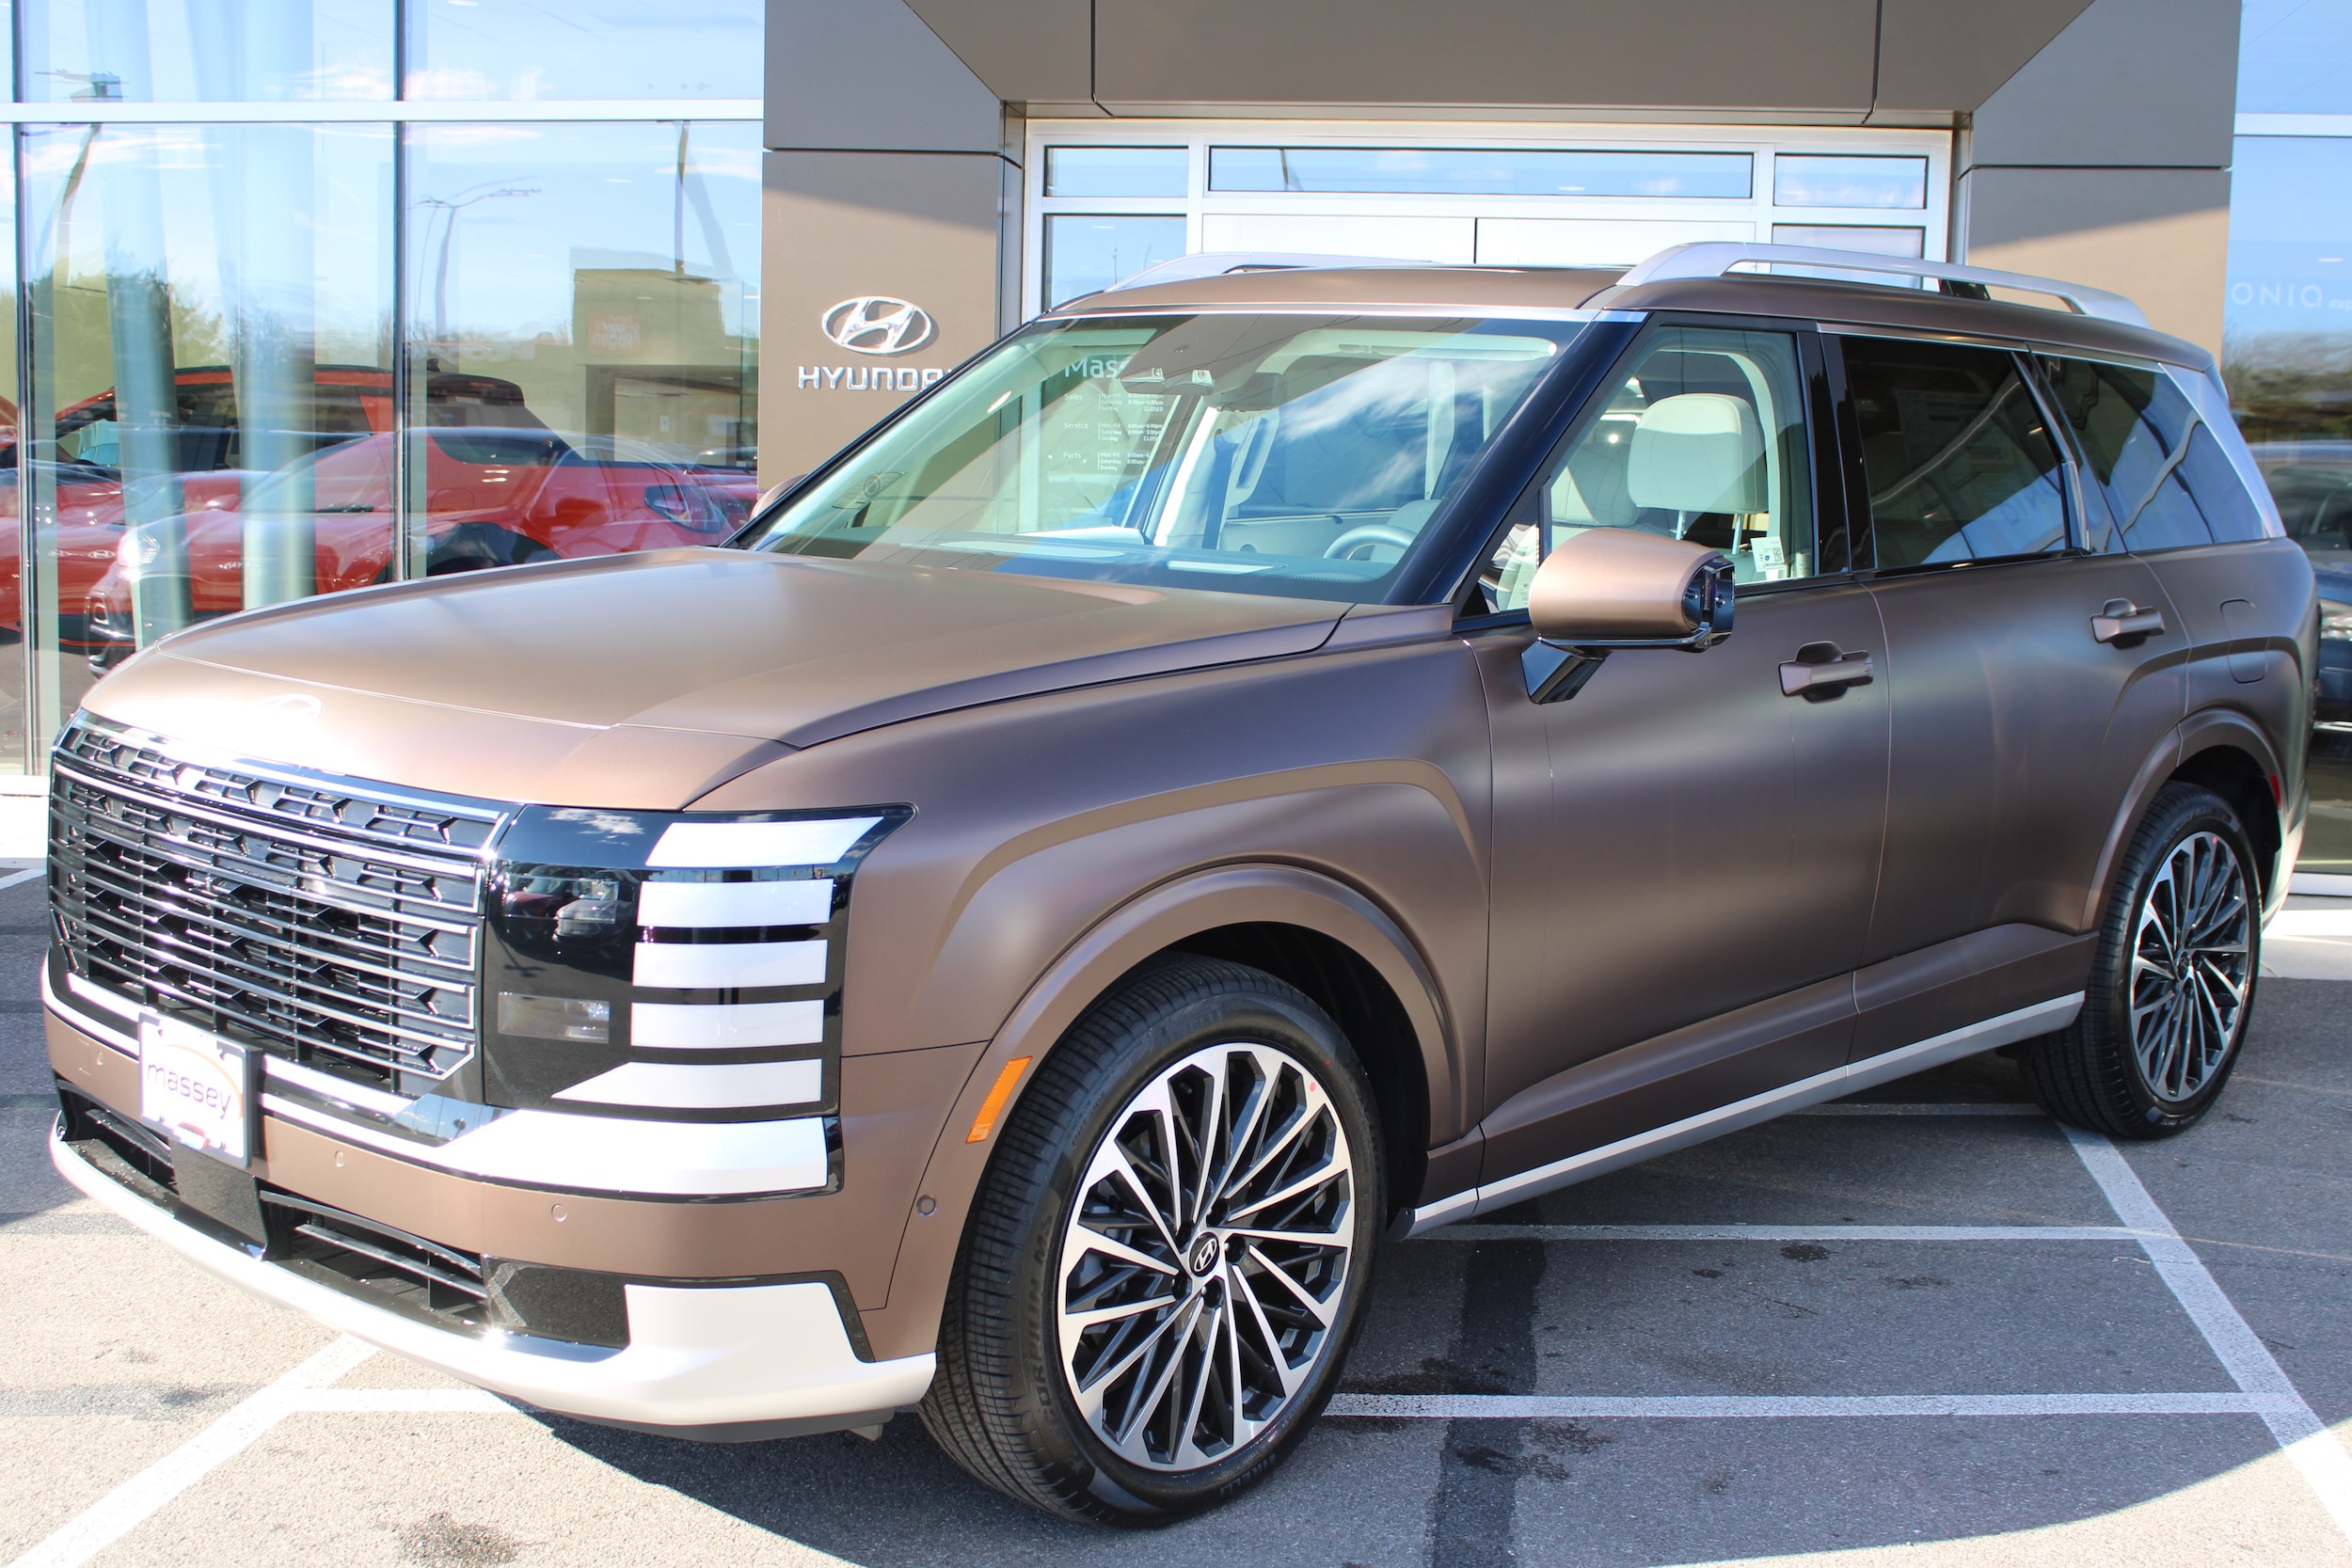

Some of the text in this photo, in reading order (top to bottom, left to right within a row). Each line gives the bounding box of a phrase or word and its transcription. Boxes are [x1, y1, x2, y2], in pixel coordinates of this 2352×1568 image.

[798, 365, 952, 391] HYUNDA
[1064, 393, 1083, 402] Sales
[1063, 421, 1089, 430] Service
[1062, 451, 1082, 460] Parts
[147, 1062, 231, 1120] massey
